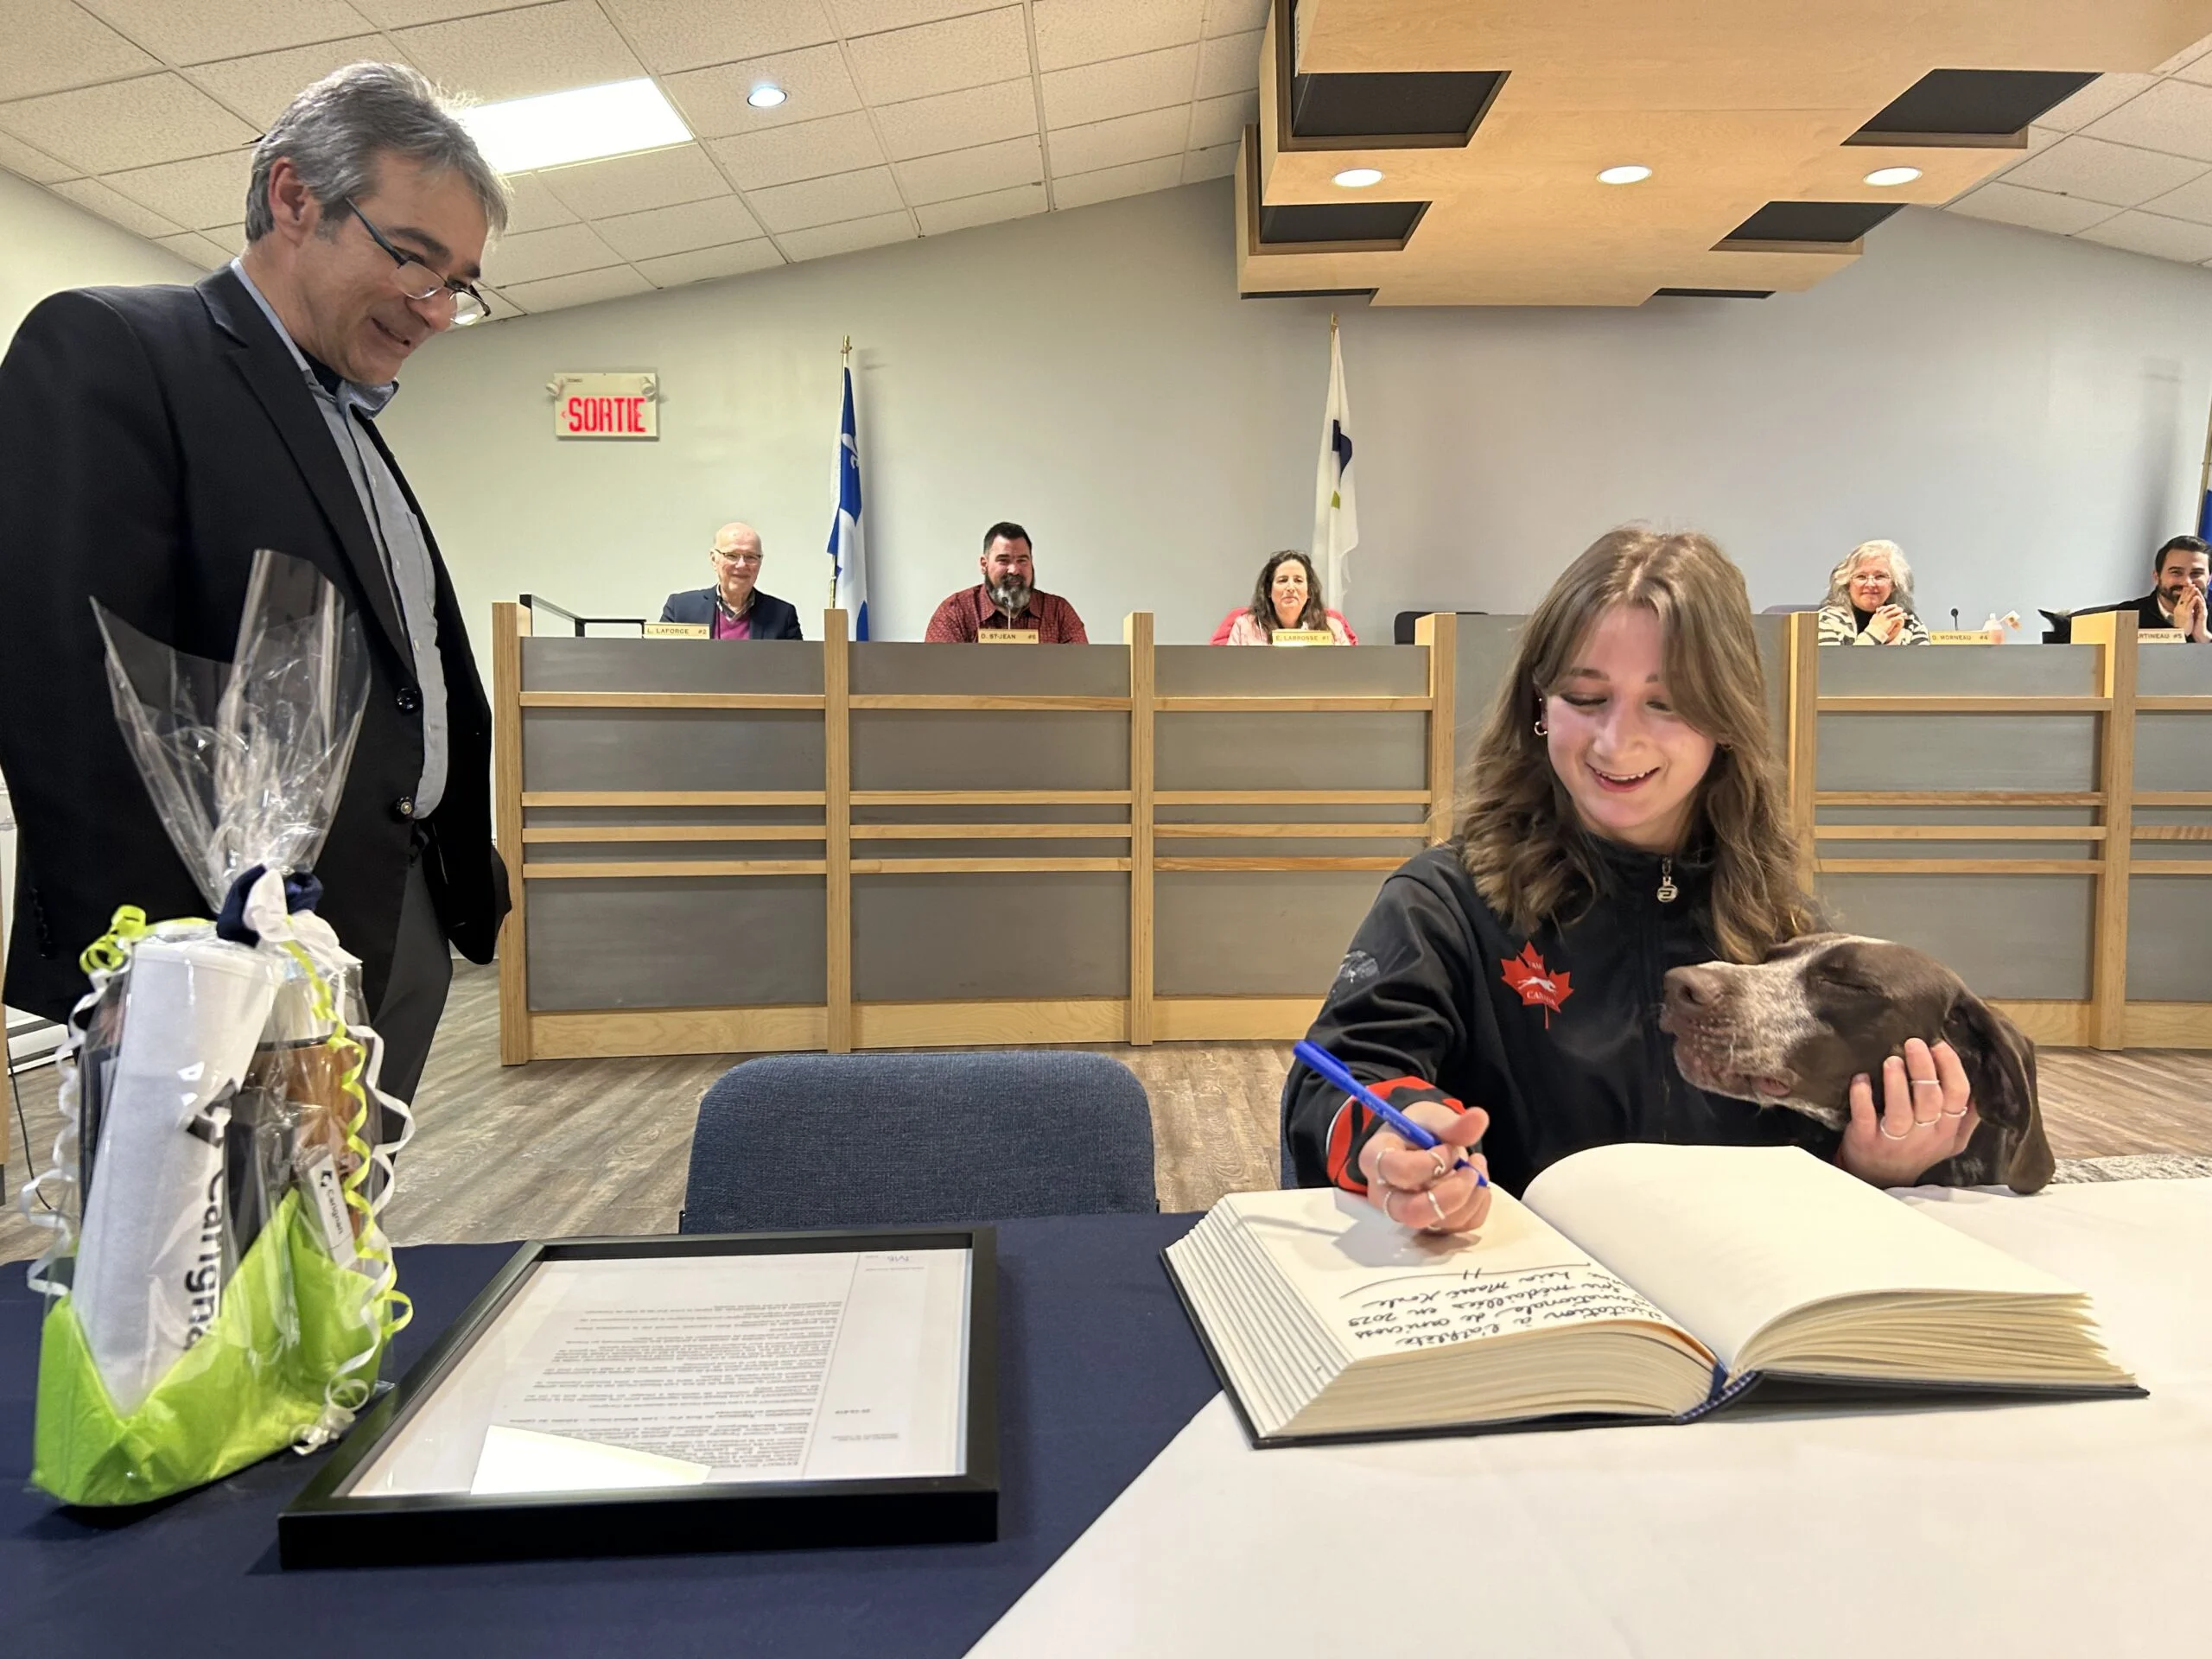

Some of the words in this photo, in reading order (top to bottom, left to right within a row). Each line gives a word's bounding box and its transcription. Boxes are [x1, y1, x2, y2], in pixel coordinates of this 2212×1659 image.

[568, 397, 646, 433] SORTIE
[327, 1188, 344, 1236] Carignan
[1406, 1306, 1439, 1316] en
[1459, 1312, 1487, 1323] de
[1347, 1312, 1397, 1328] 2023
